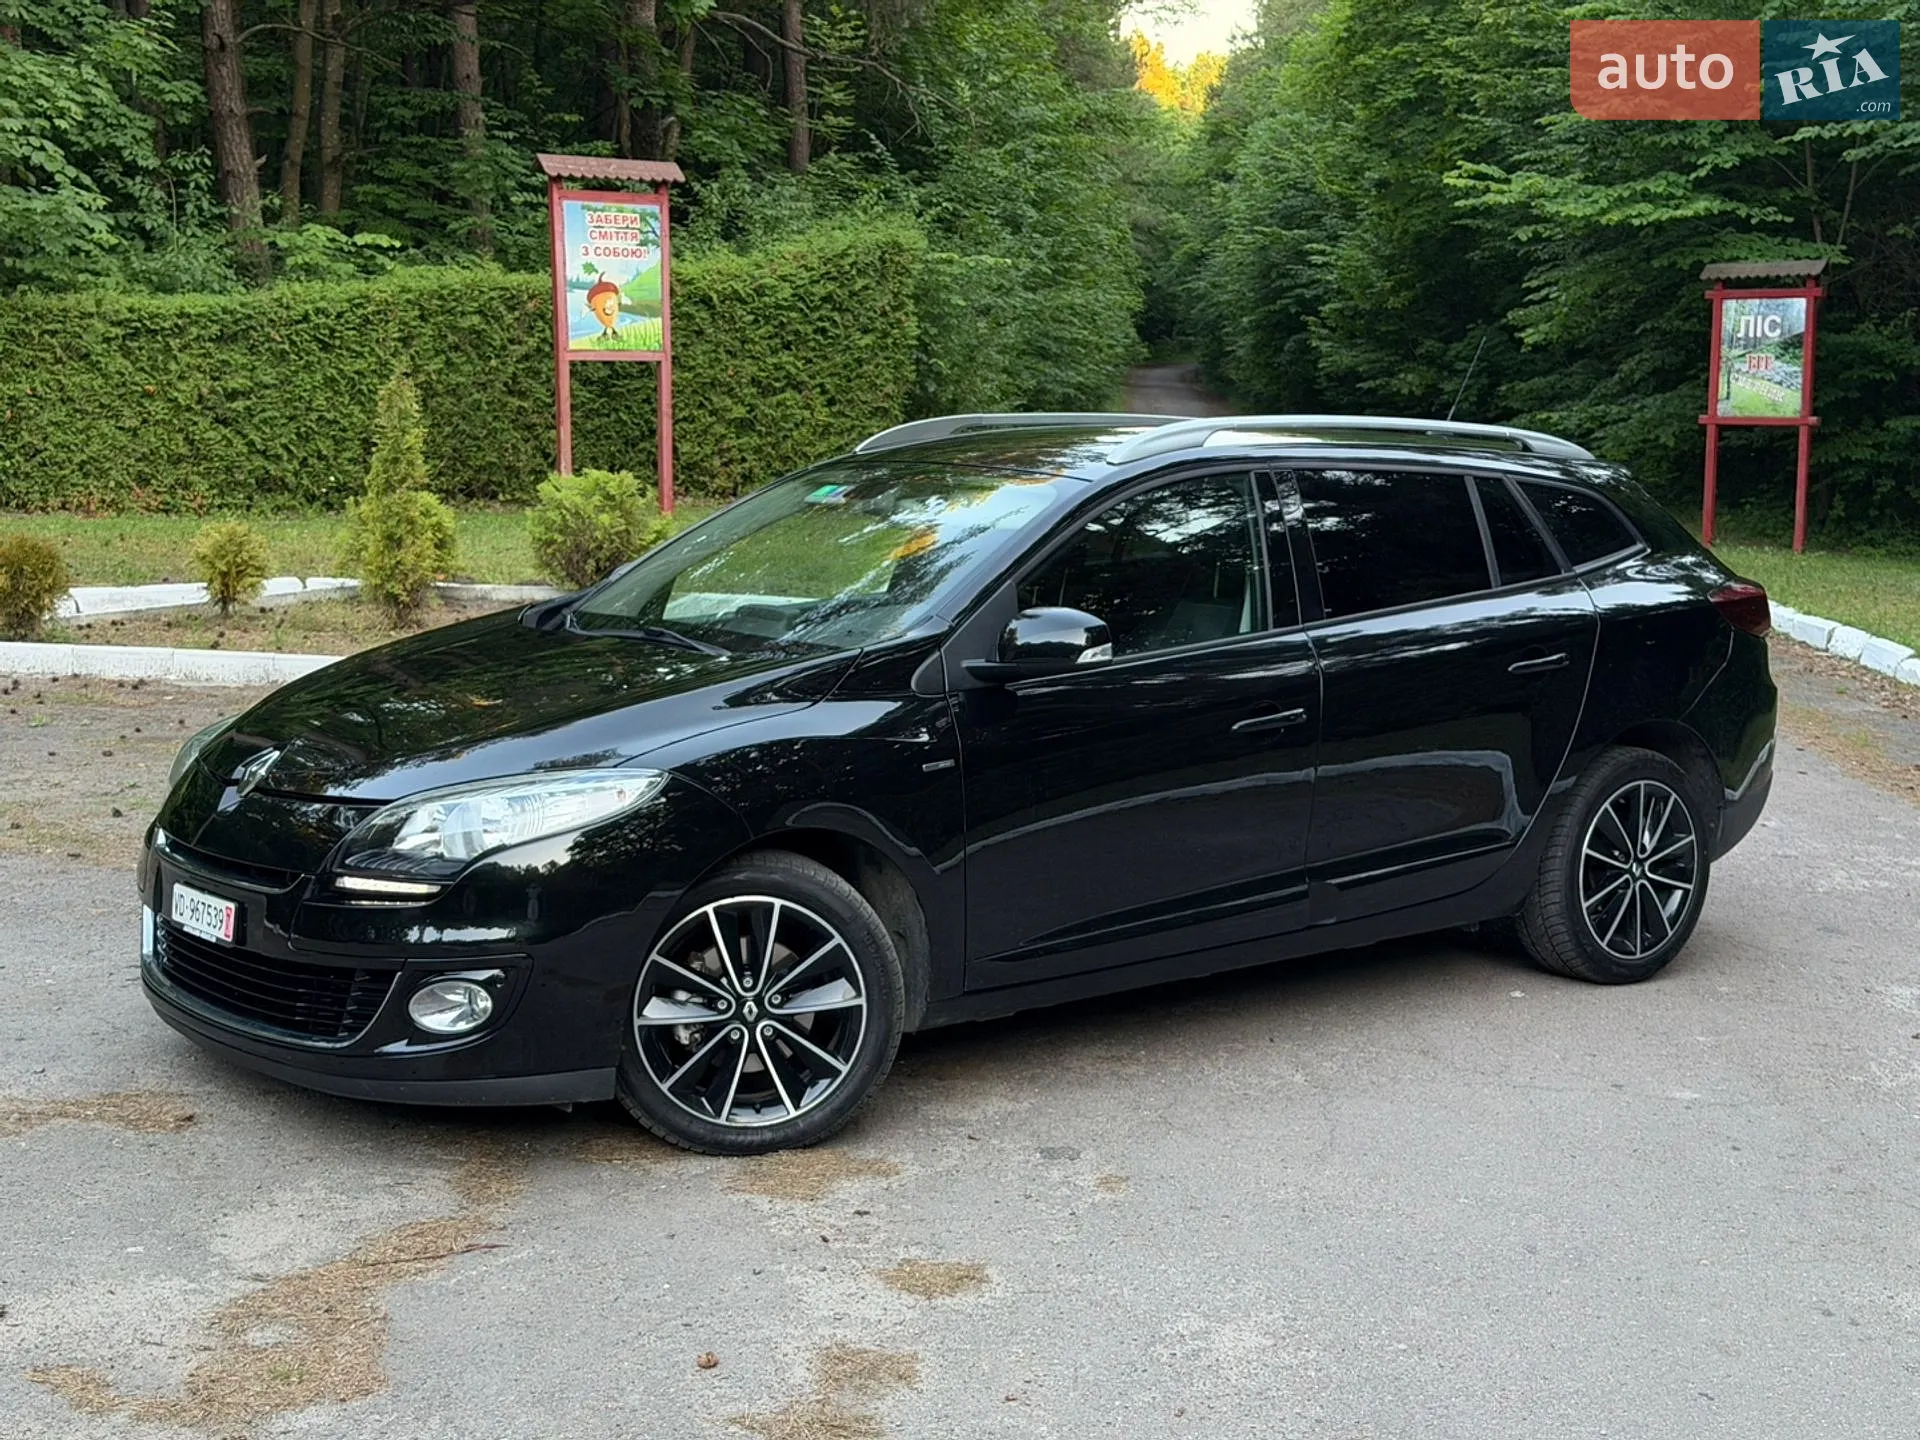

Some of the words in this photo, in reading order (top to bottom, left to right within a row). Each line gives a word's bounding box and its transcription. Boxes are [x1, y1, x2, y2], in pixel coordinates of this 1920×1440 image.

[587, 212, 639, 226] ЗАБЕРИ
[589, 229, 639, 242] СМІТТЯ
[1737, 314, 1782, 338] ЛІС
